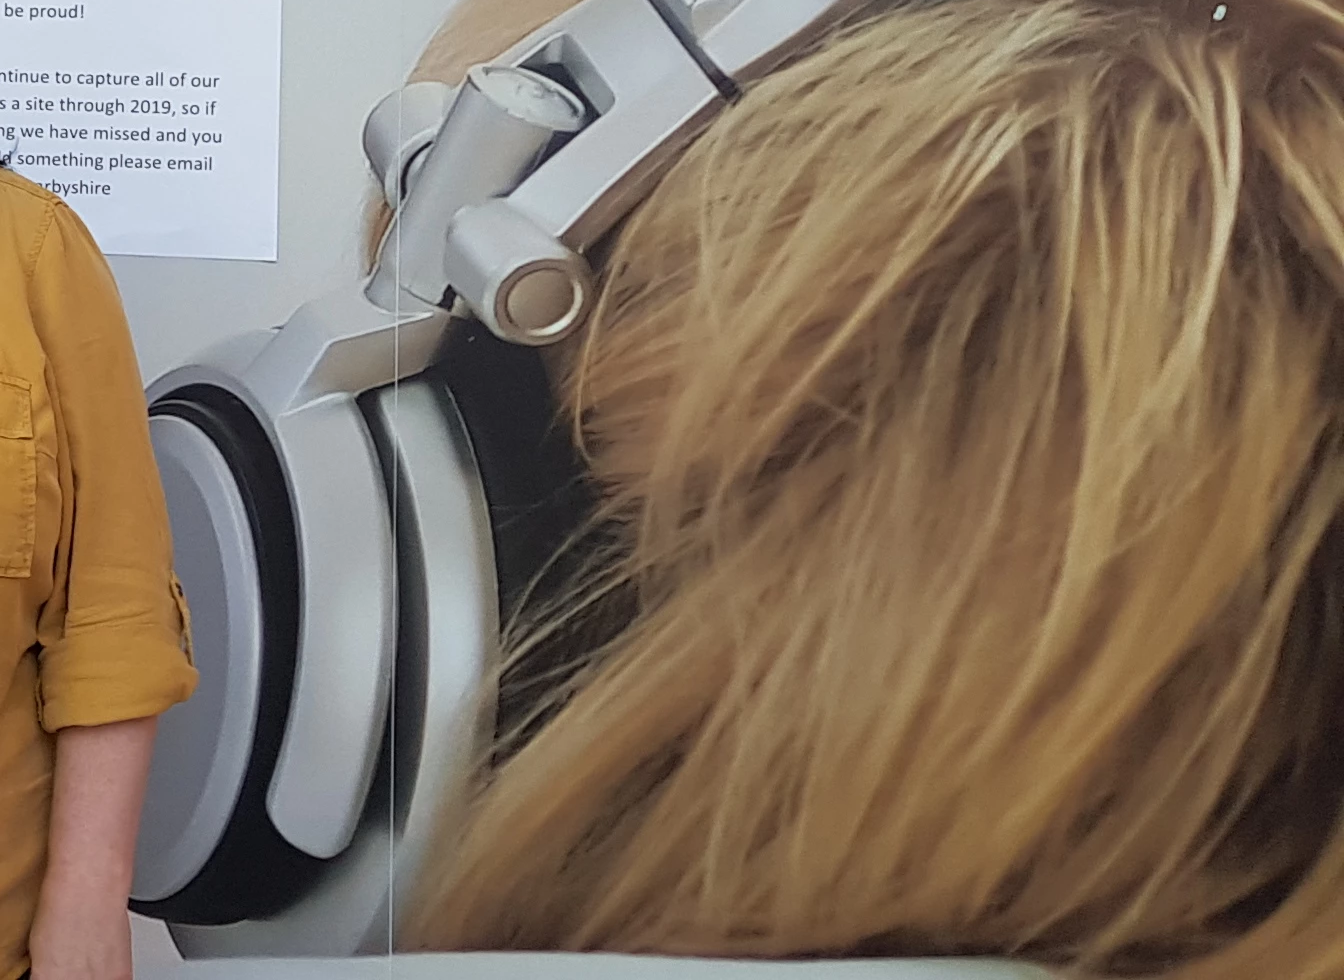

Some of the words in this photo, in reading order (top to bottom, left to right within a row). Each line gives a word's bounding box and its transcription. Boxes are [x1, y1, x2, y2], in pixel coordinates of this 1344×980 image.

[4, 2, 23, 17] be
[29, 4, 83, 20] proud!
[55, 71, 71, 84] to
[76, 73, 139, 88] capture
[145, 71, 163, 86] all
[169, 72, 186, 86] of
[190, 76, 219, 87] our
[11, 99, 19, 110] a
[25, 96, 54, 111] site
[59, 97, 124, 116] through
[130, 99, 175, 117] 2019,
[181, 104, 199, 115] so
[205, 100, 216, 115] if
